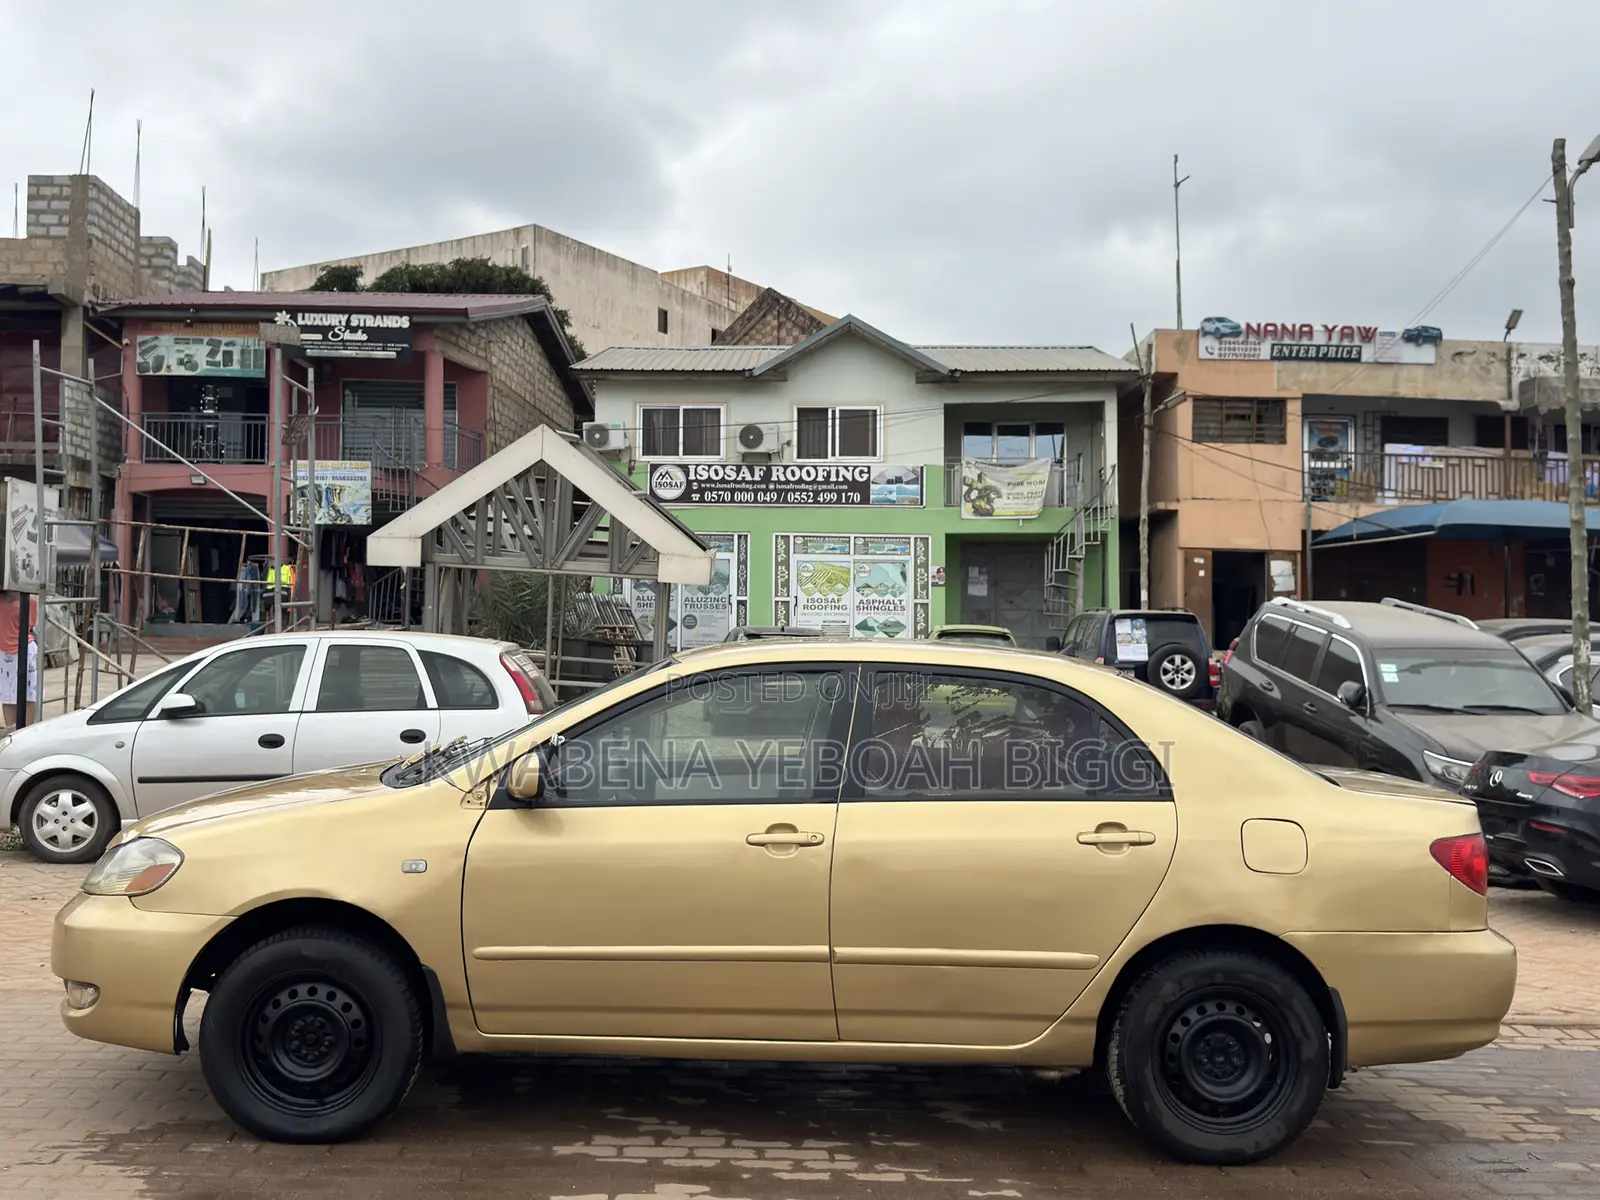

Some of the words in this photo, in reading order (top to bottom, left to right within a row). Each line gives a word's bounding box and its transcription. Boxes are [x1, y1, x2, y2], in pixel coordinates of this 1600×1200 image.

[297, 313, 349, 326] LUXURY
[350, 314, 411, 329] STRANDS
[328, 326, 369, 342] Studio
[1245, 322, 1314, 342] NANA
[1322, 325, 1378, 344] YAW
[687, 465, 767, 481] ISOSAF
[770, 465, 870, 482] ROOFING
[704, 491, 731, 502] 0570
[734, 491, 754, 502] 000
[757, 491, 778, 502] 049
[780, 492, 785, 502] /
[787, 492, 814, 503] 0552
[817, 492, 837, 503] 499
[841, 493, 860, 503] 170
